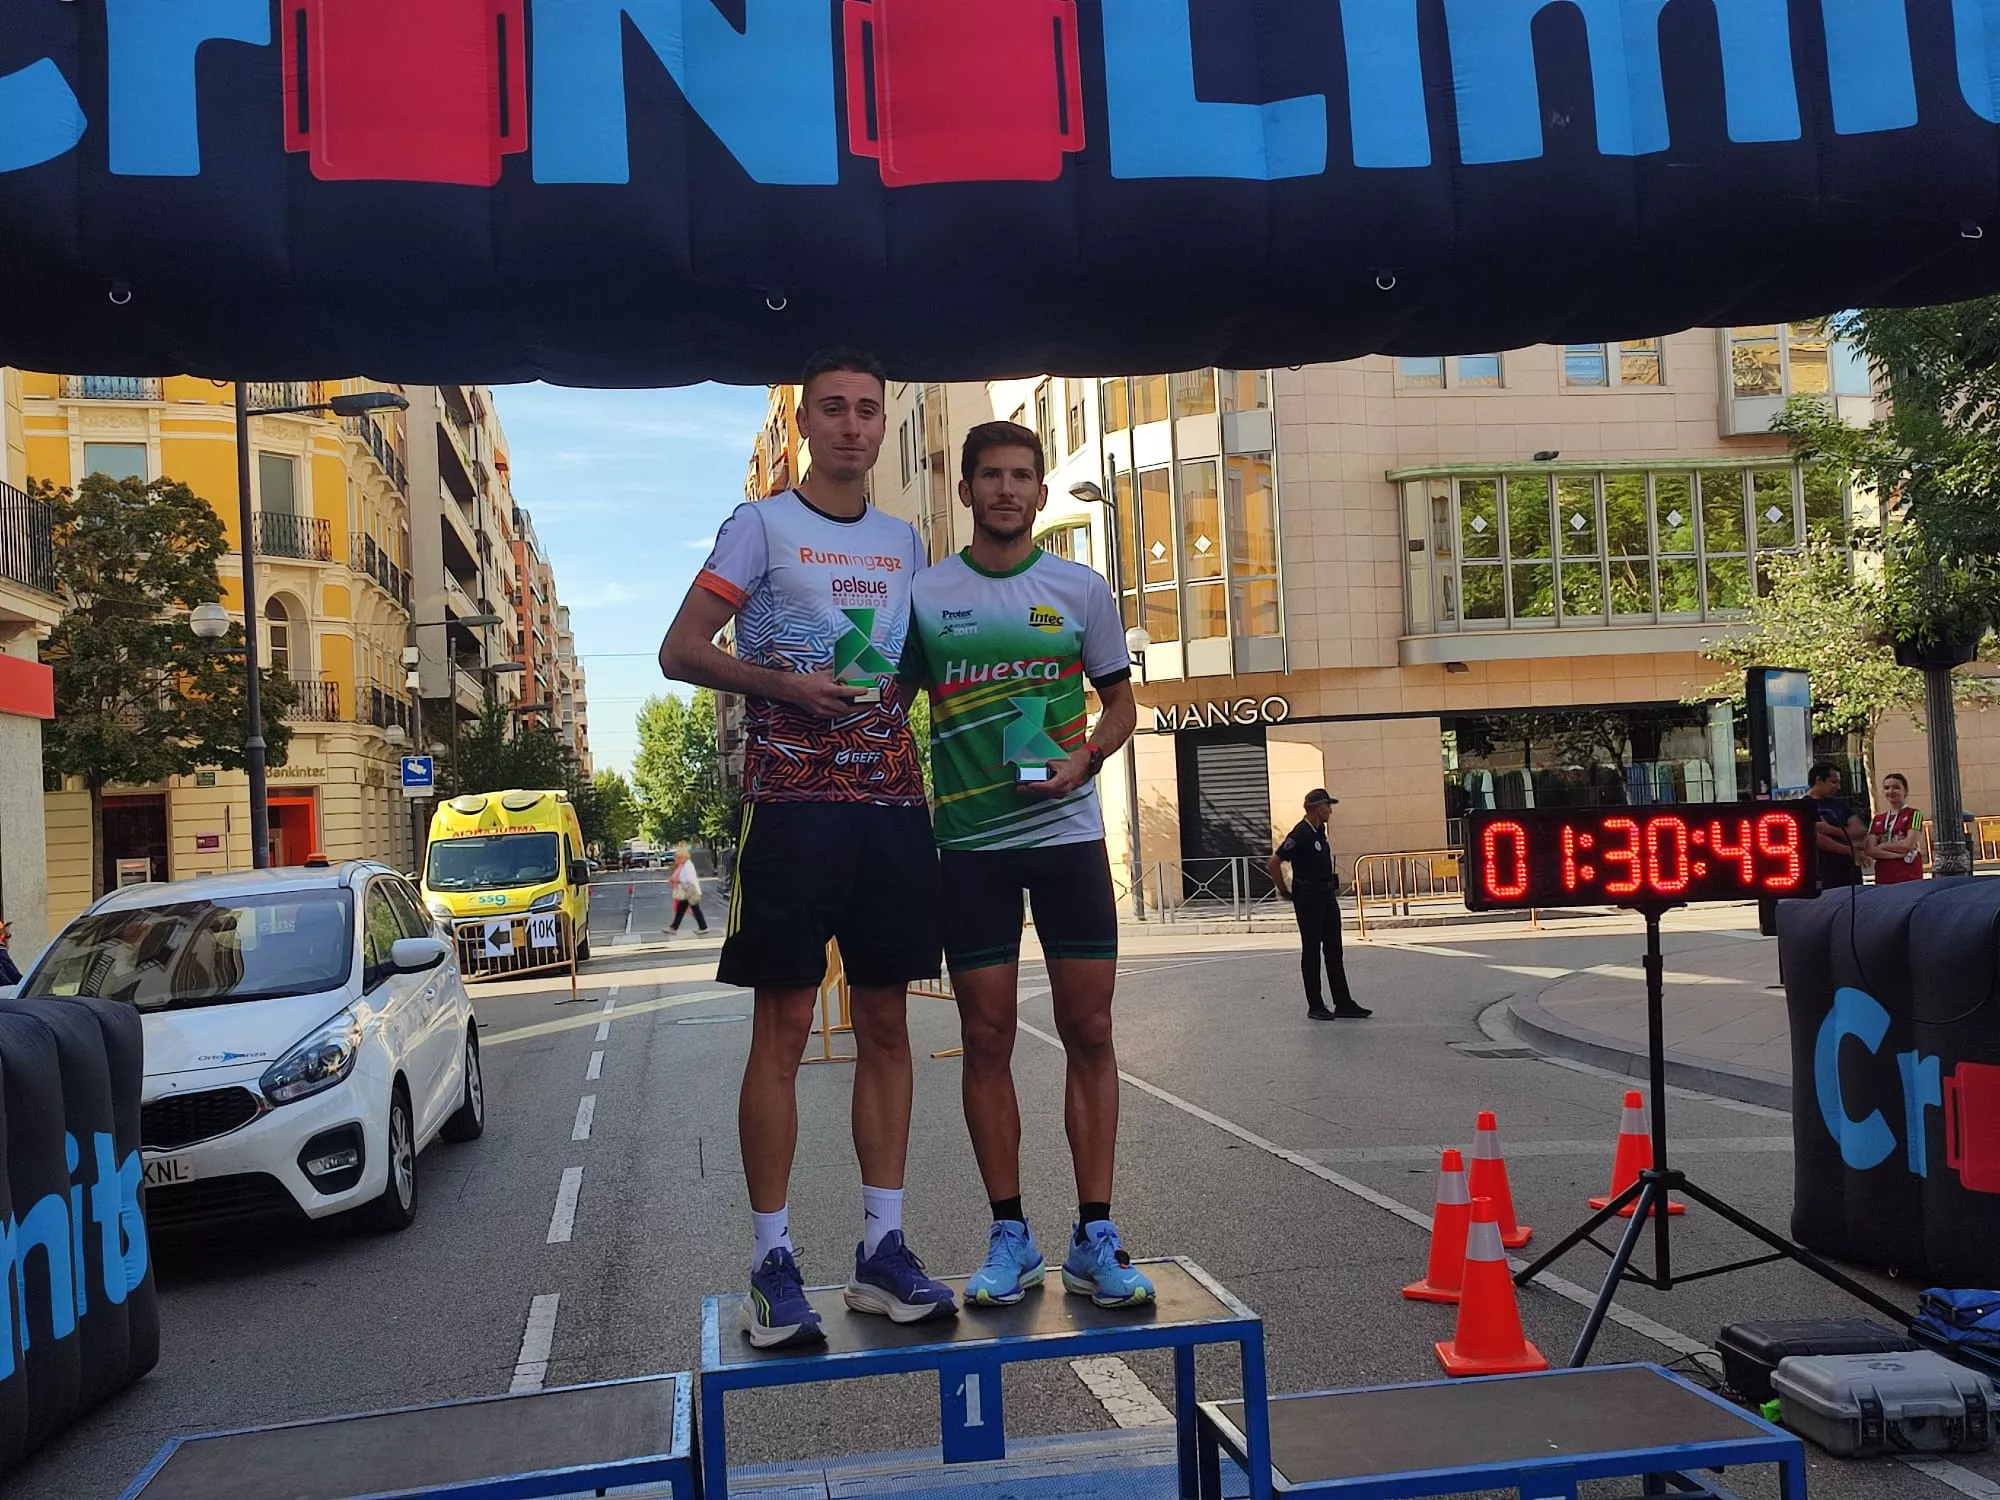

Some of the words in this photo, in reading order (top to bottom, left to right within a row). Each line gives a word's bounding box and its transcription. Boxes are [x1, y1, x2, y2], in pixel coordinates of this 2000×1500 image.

[799, 547, 903, 571] Runningzgz
[942, 609, 973, 618] Protex
[945, 659, 1061, 685] Huesca
[1152, 695, 1289, 732] MANGO
[851, 752, 881, 763] GEFF
[532, 919, 555, 939] 10K
[956, 1373, 985, 1427] 1
